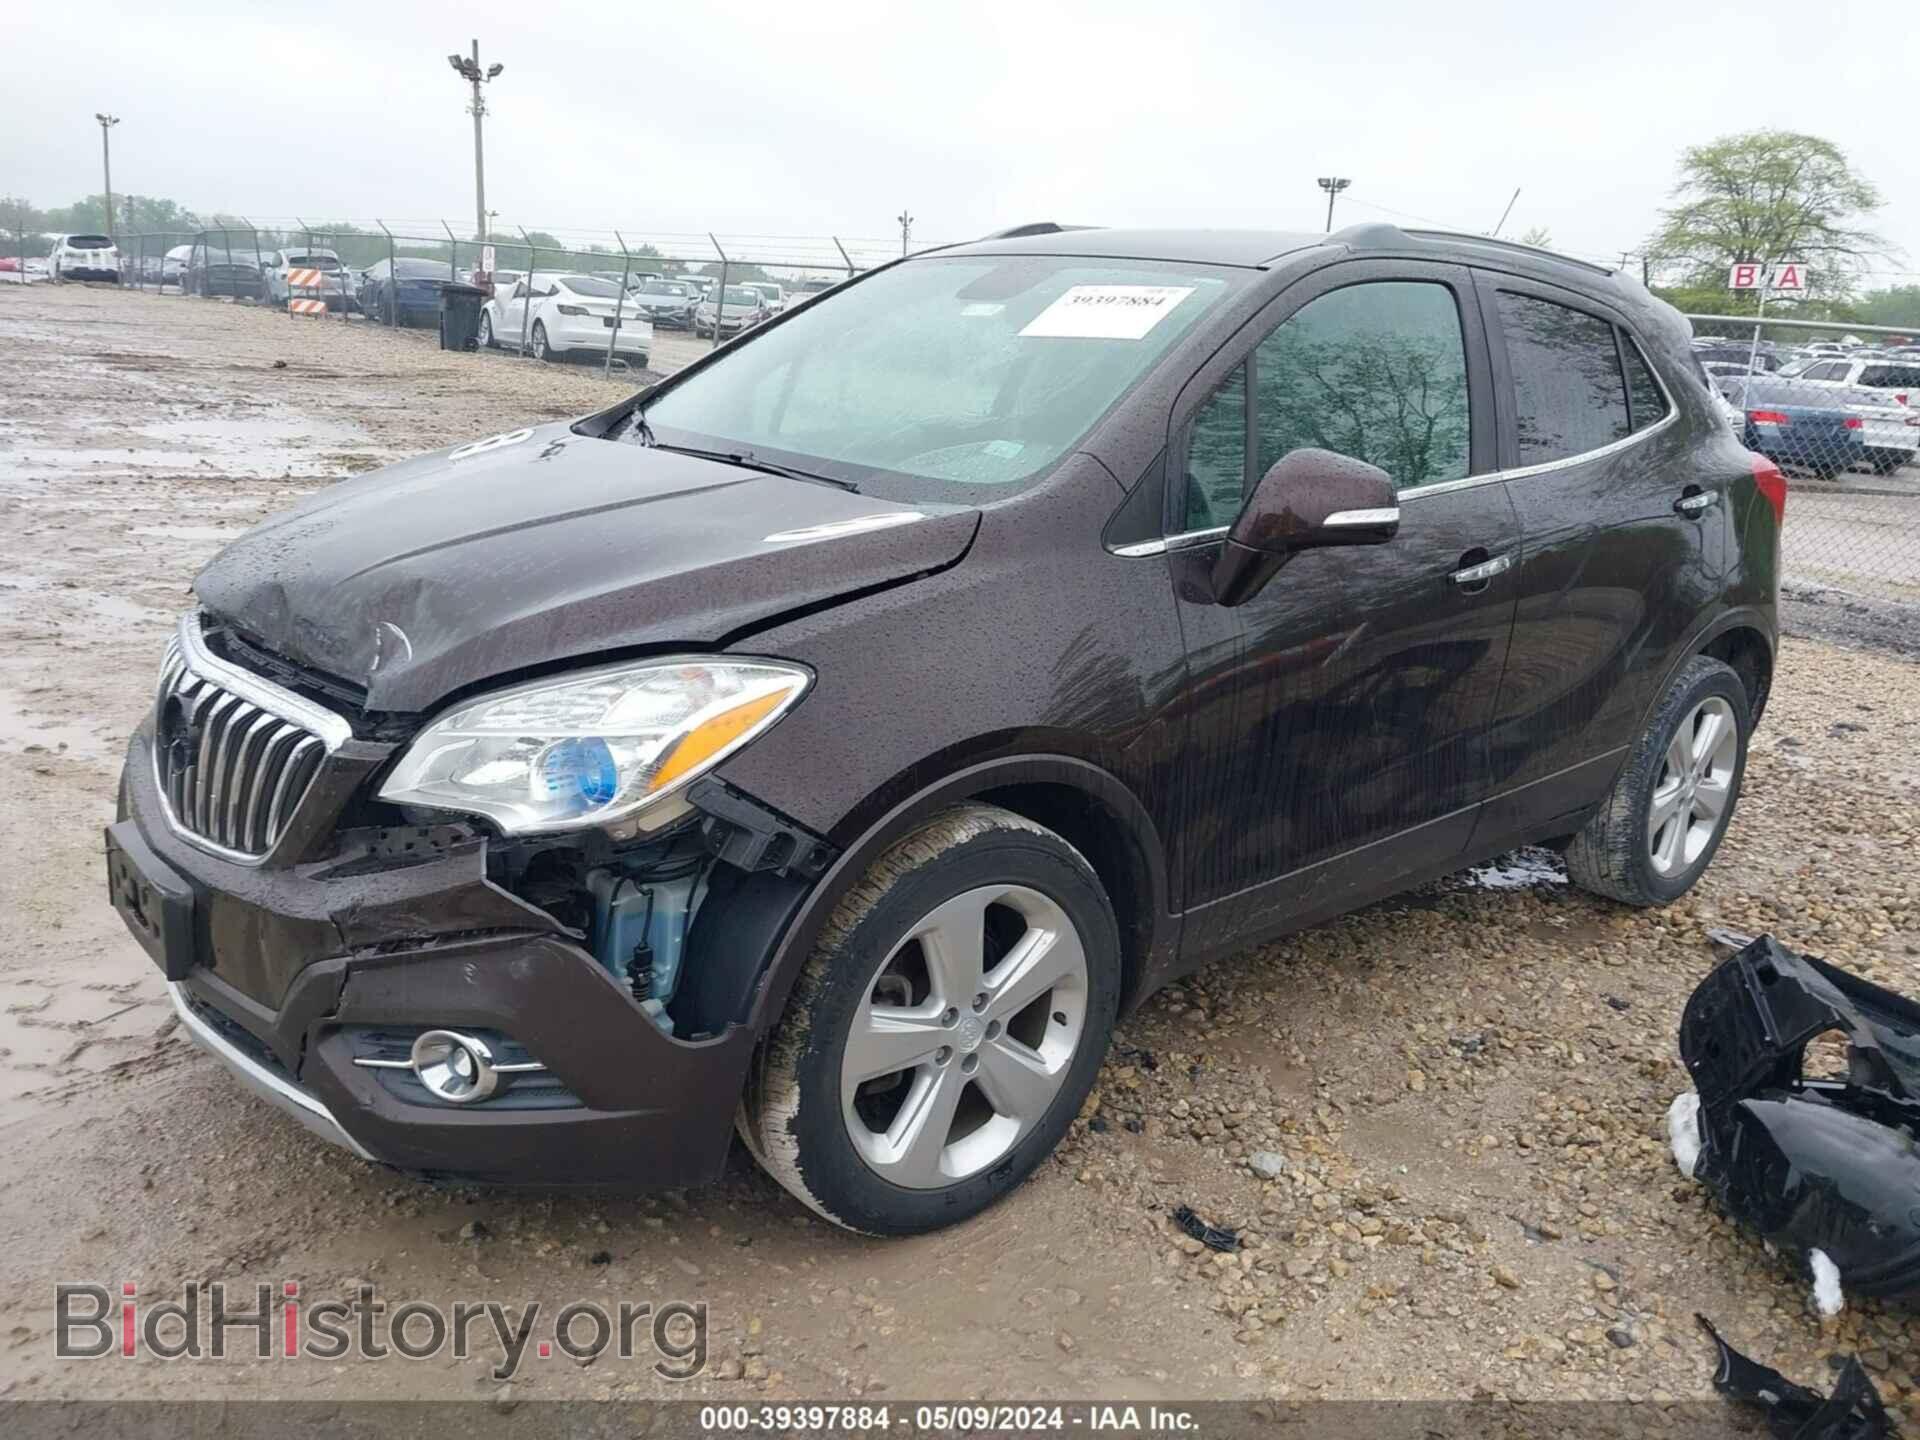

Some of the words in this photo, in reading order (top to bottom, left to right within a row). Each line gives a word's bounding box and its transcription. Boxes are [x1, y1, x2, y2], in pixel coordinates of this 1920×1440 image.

[1736, 266, 1755, 286] B
[1779, 265, 1799, 286] A
[1066, 295, 1167, 306] 39397884
